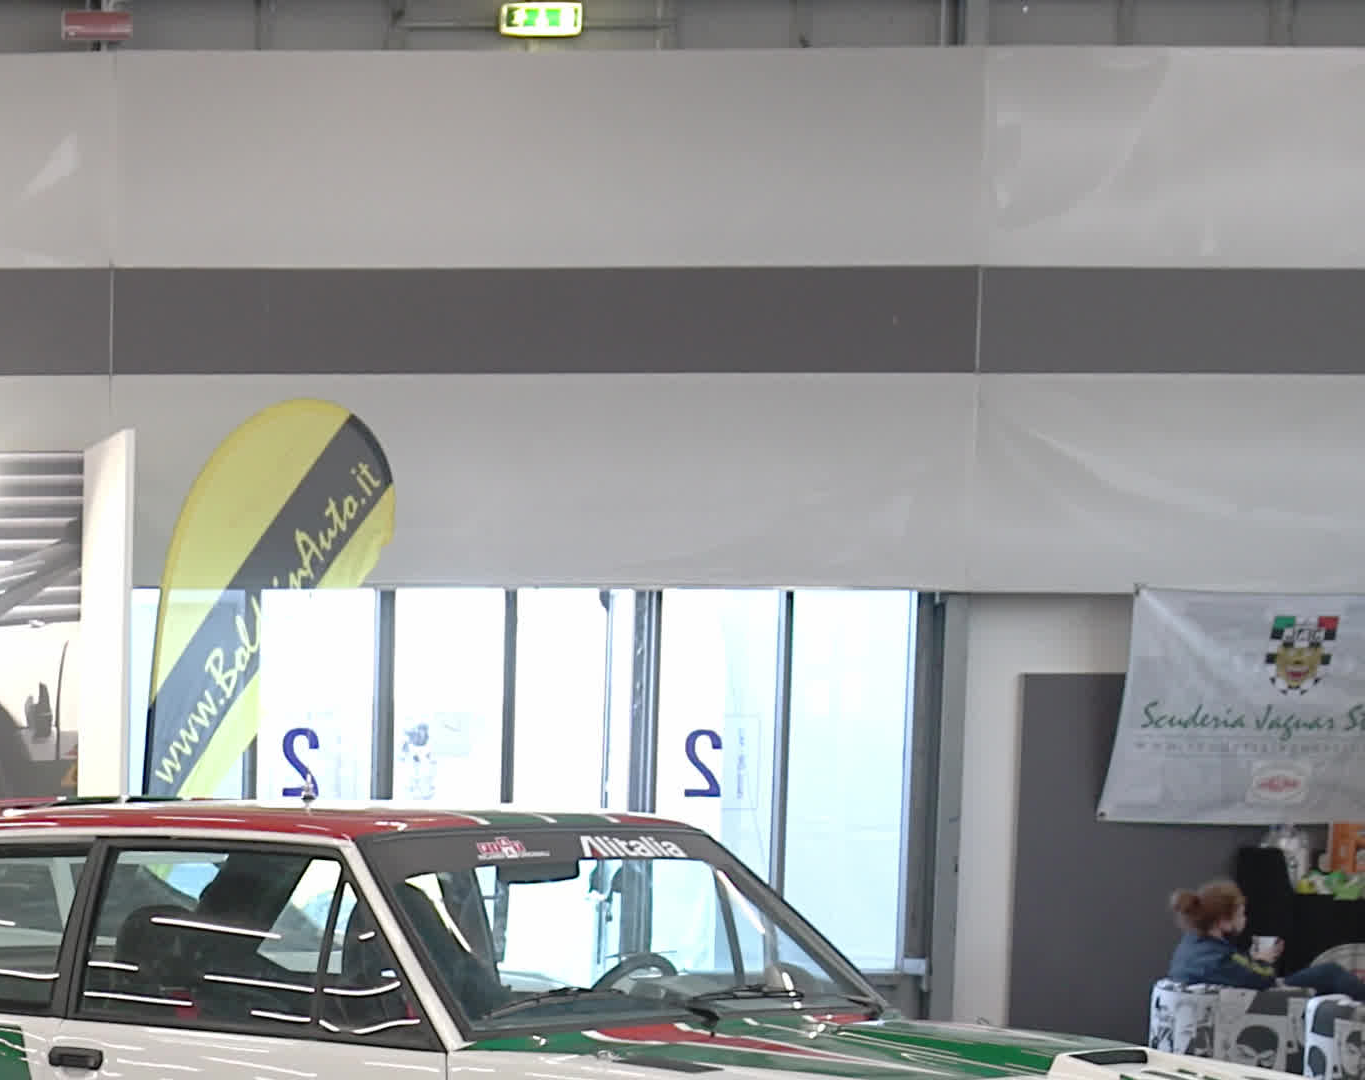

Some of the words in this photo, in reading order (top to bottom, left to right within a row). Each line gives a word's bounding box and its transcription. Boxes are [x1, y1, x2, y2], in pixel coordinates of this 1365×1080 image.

[1140, 700, 1246, 730] Scuderia
[1254, 703, 1335, 741] Jaguar
[580, 835, 688, 858] Alitalia
